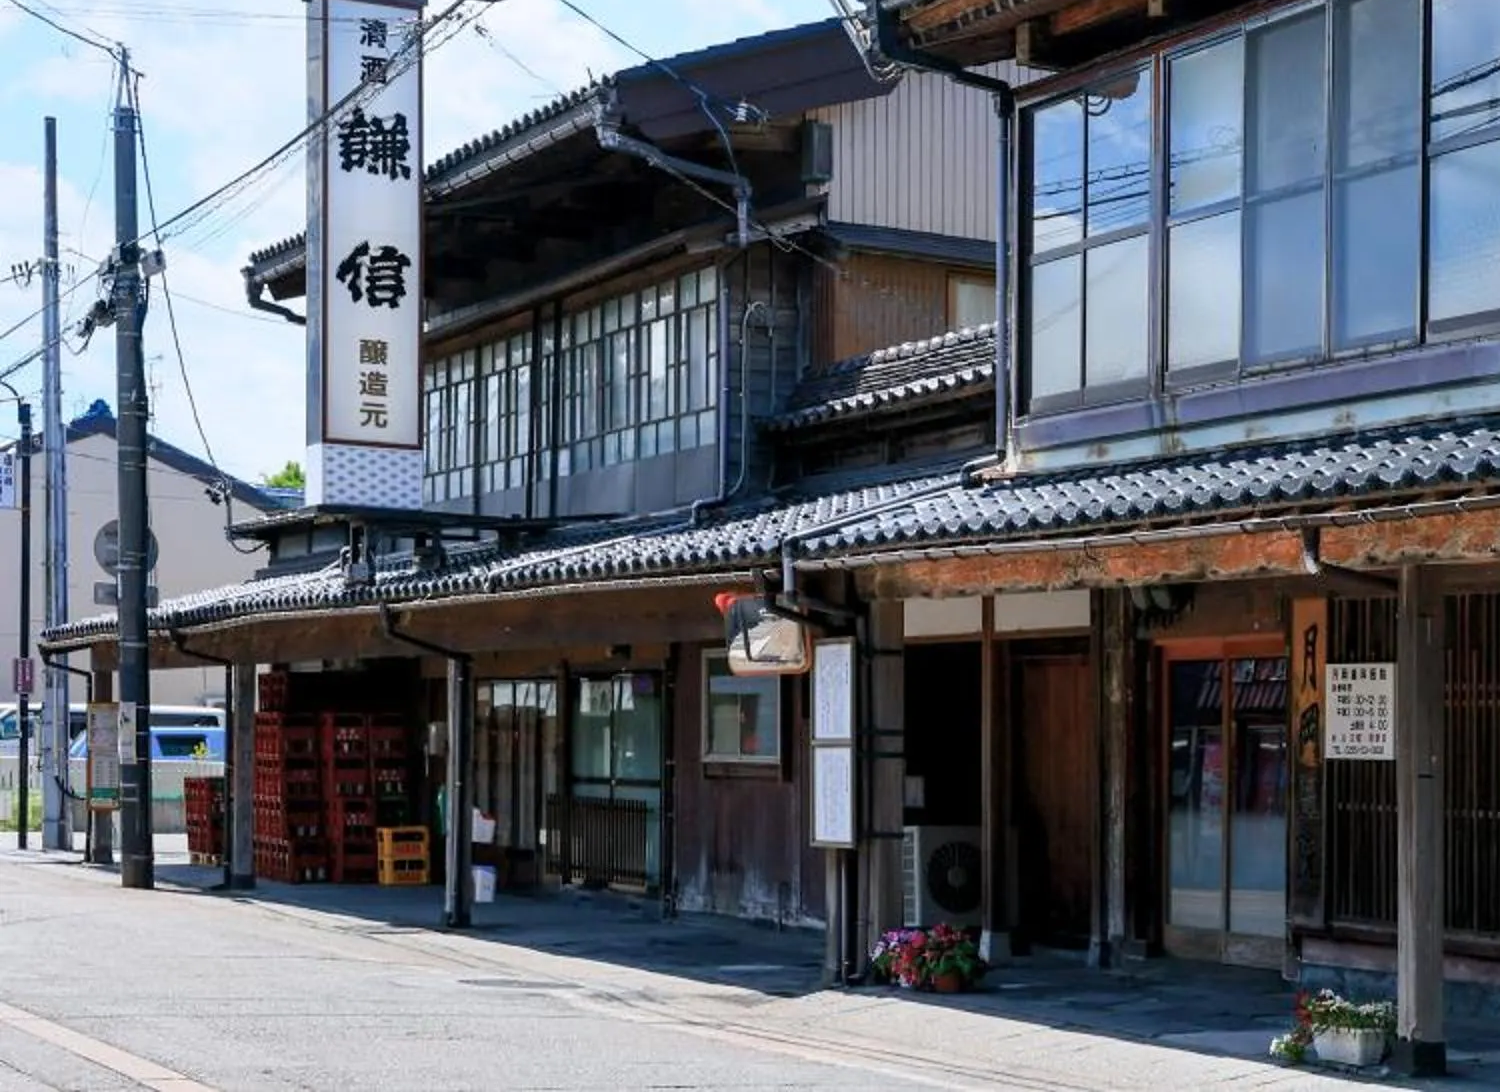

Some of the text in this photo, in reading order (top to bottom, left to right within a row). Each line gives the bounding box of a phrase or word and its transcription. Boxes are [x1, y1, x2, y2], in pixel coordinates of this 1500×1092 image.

[336, 18, 412, 429] 清酒 謙信 醸造元
